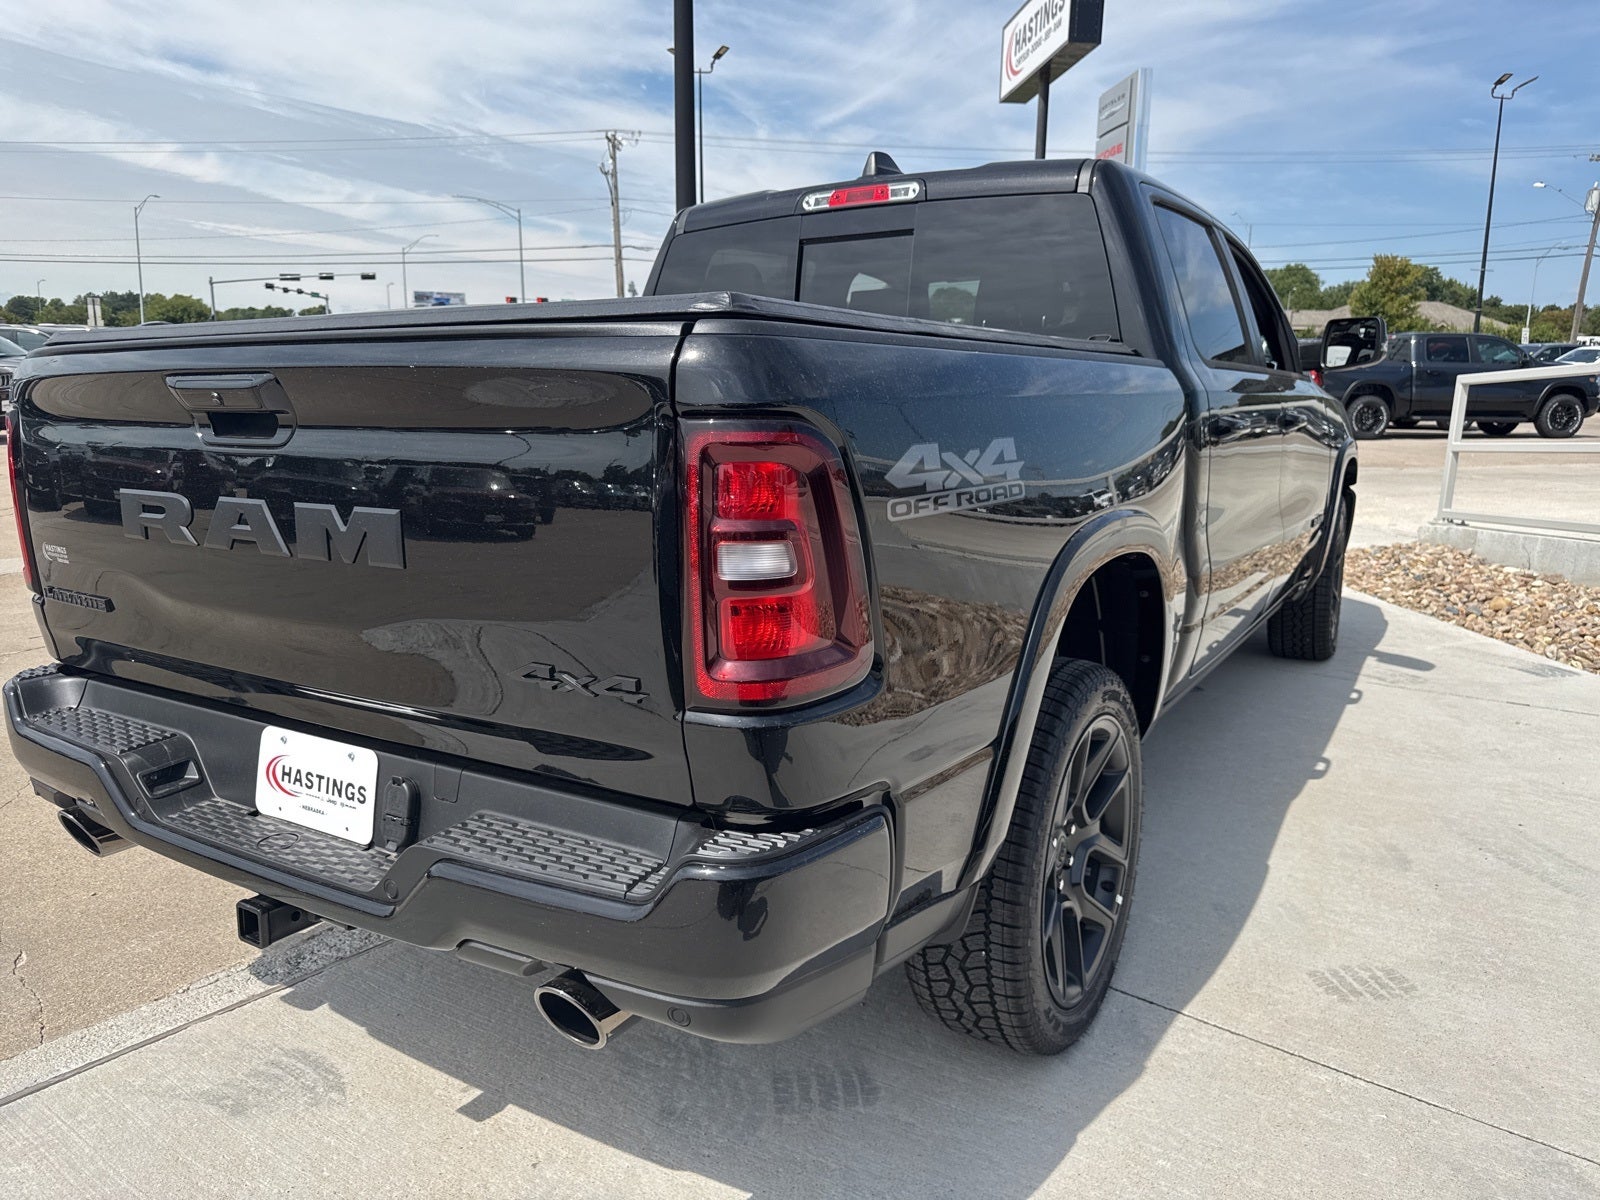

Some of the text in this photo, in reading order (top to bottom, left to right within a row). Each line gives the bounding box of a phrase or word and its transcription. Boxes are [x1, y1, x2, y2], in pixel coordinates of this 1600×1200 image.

[890, 484, 1023, 517] OFF ROAD
[120, 488, 406, 569] RAM
[281, 764, 367, 804] HASTINGS
